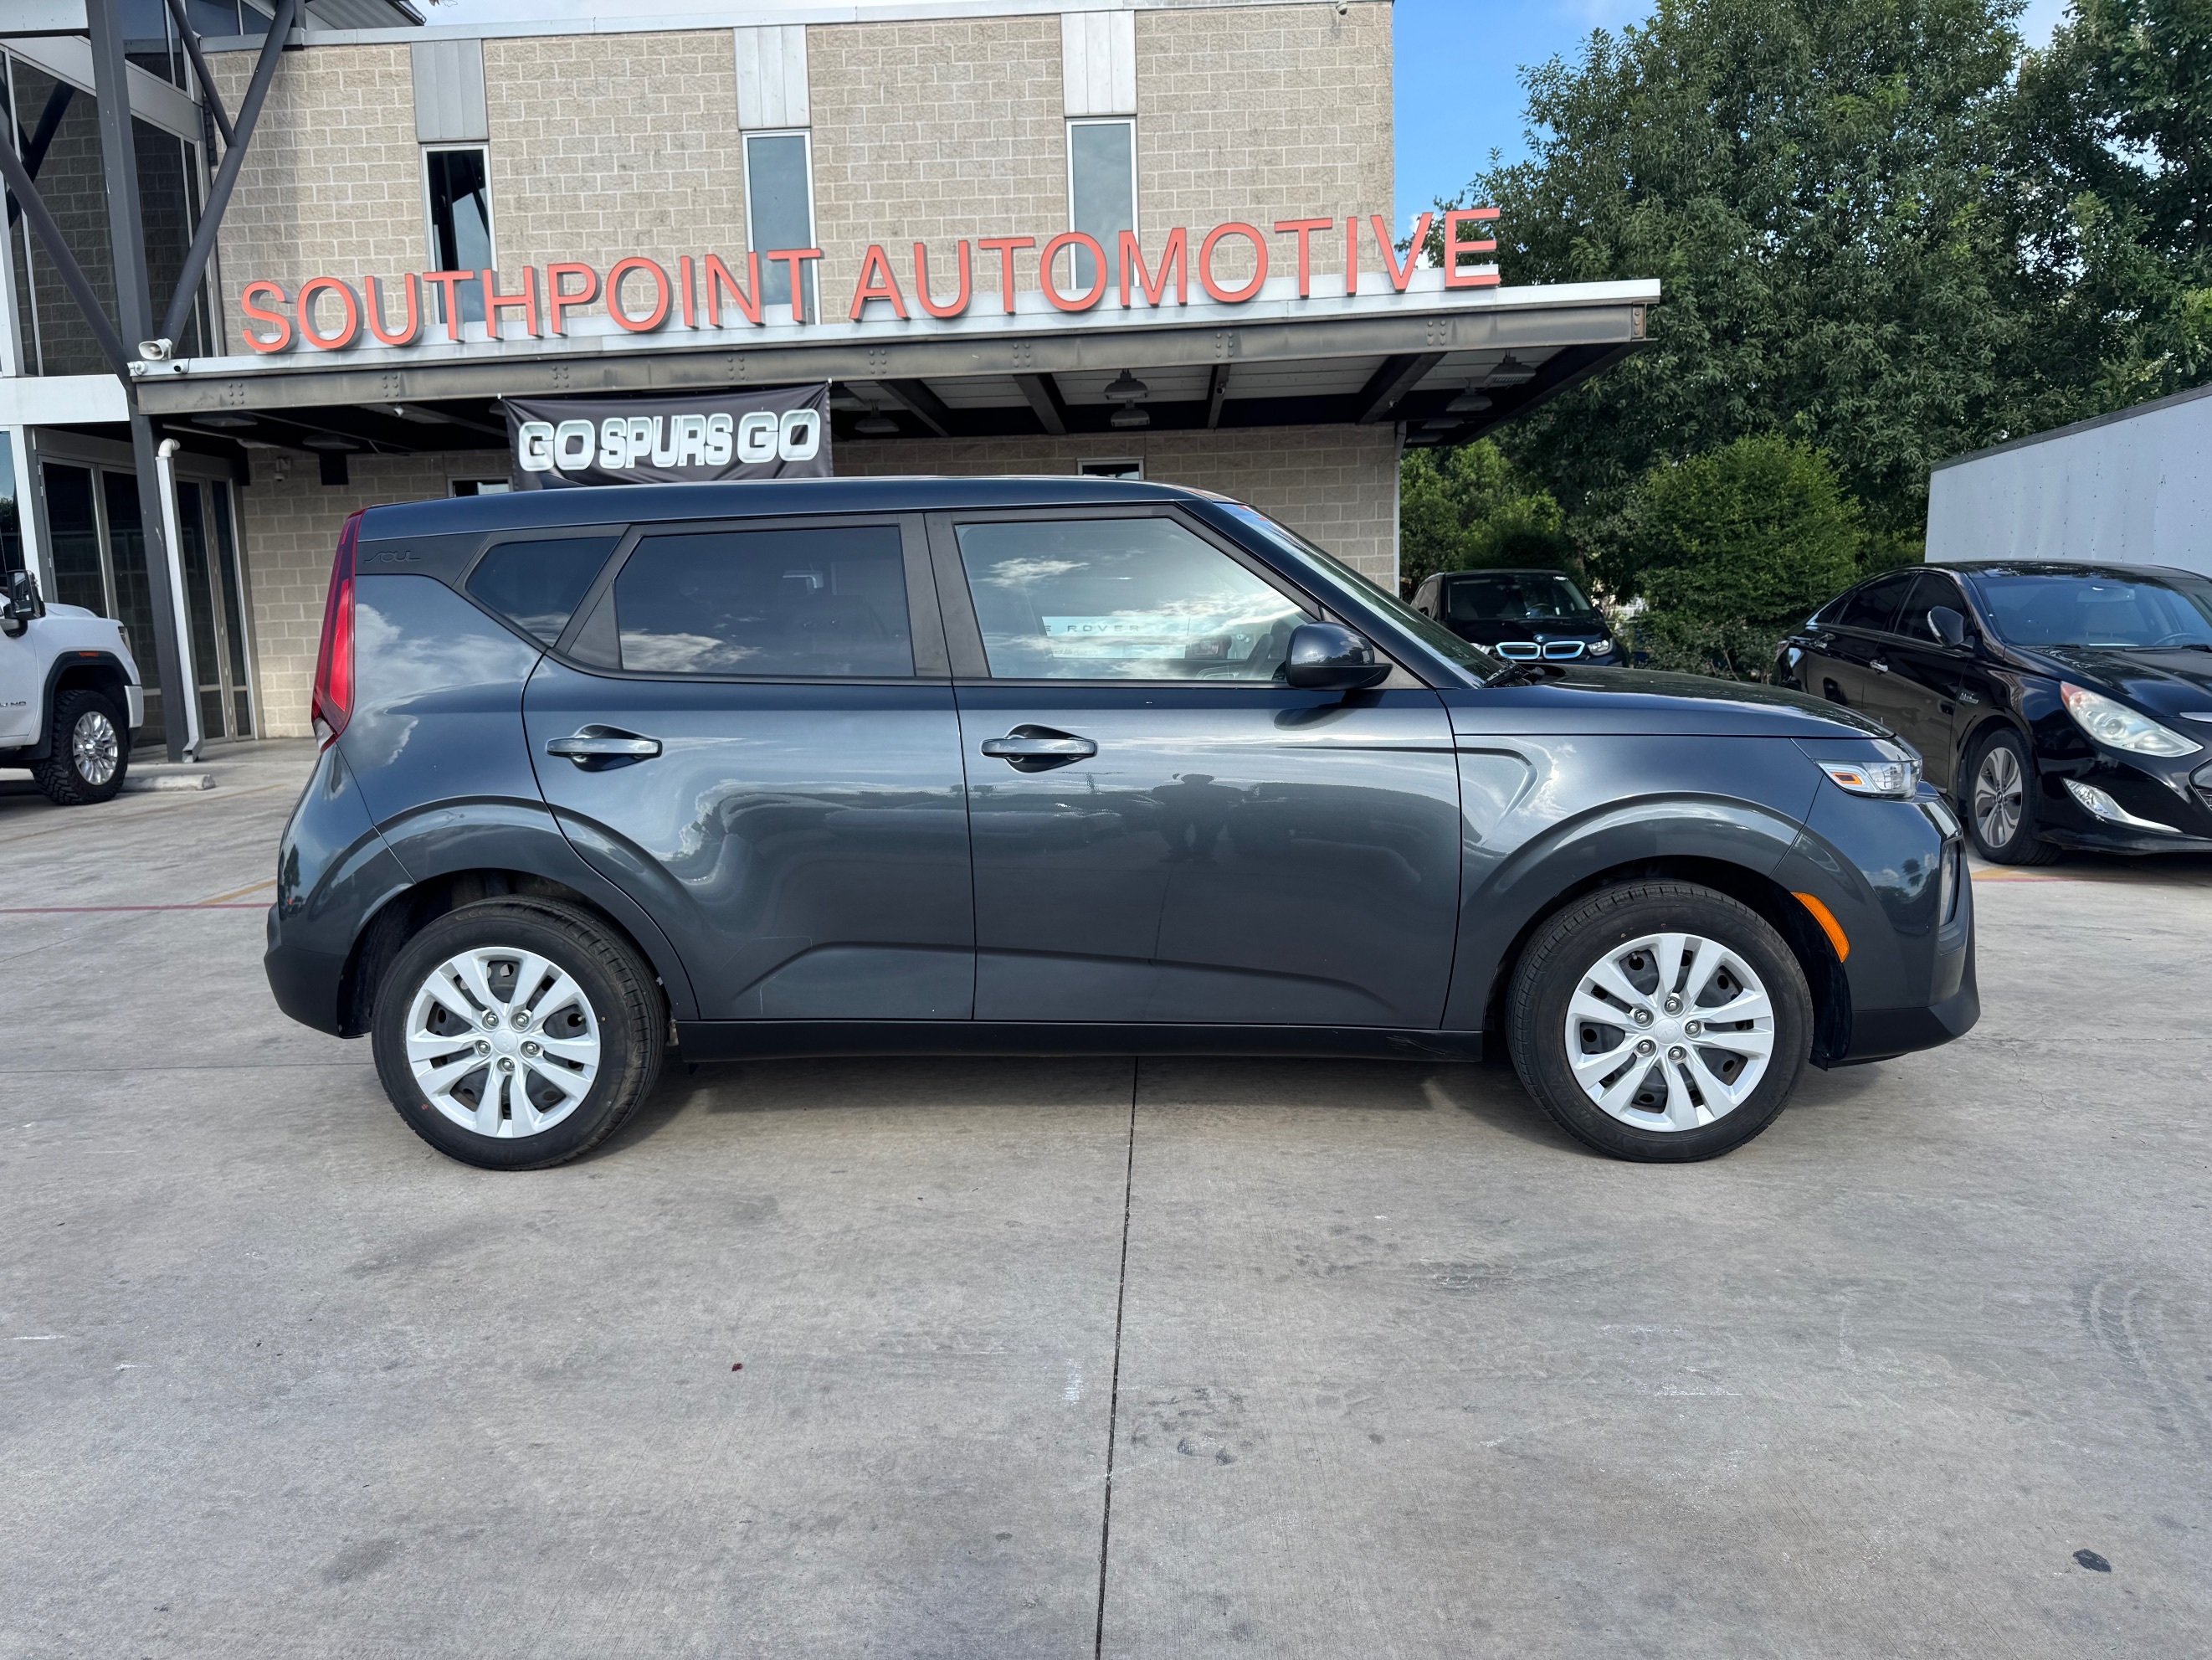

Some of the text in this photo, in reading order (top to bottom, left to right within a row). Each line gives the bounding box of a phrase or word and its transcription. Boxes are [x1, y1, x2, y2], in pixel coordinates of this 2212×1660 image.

[241, 208, 1501, 353] SOUTHPOINT AUTOMOTIVE
[518, 408, 821, 471] GO SPURS GO
[1067, 624, 1140, 633] ROVER
